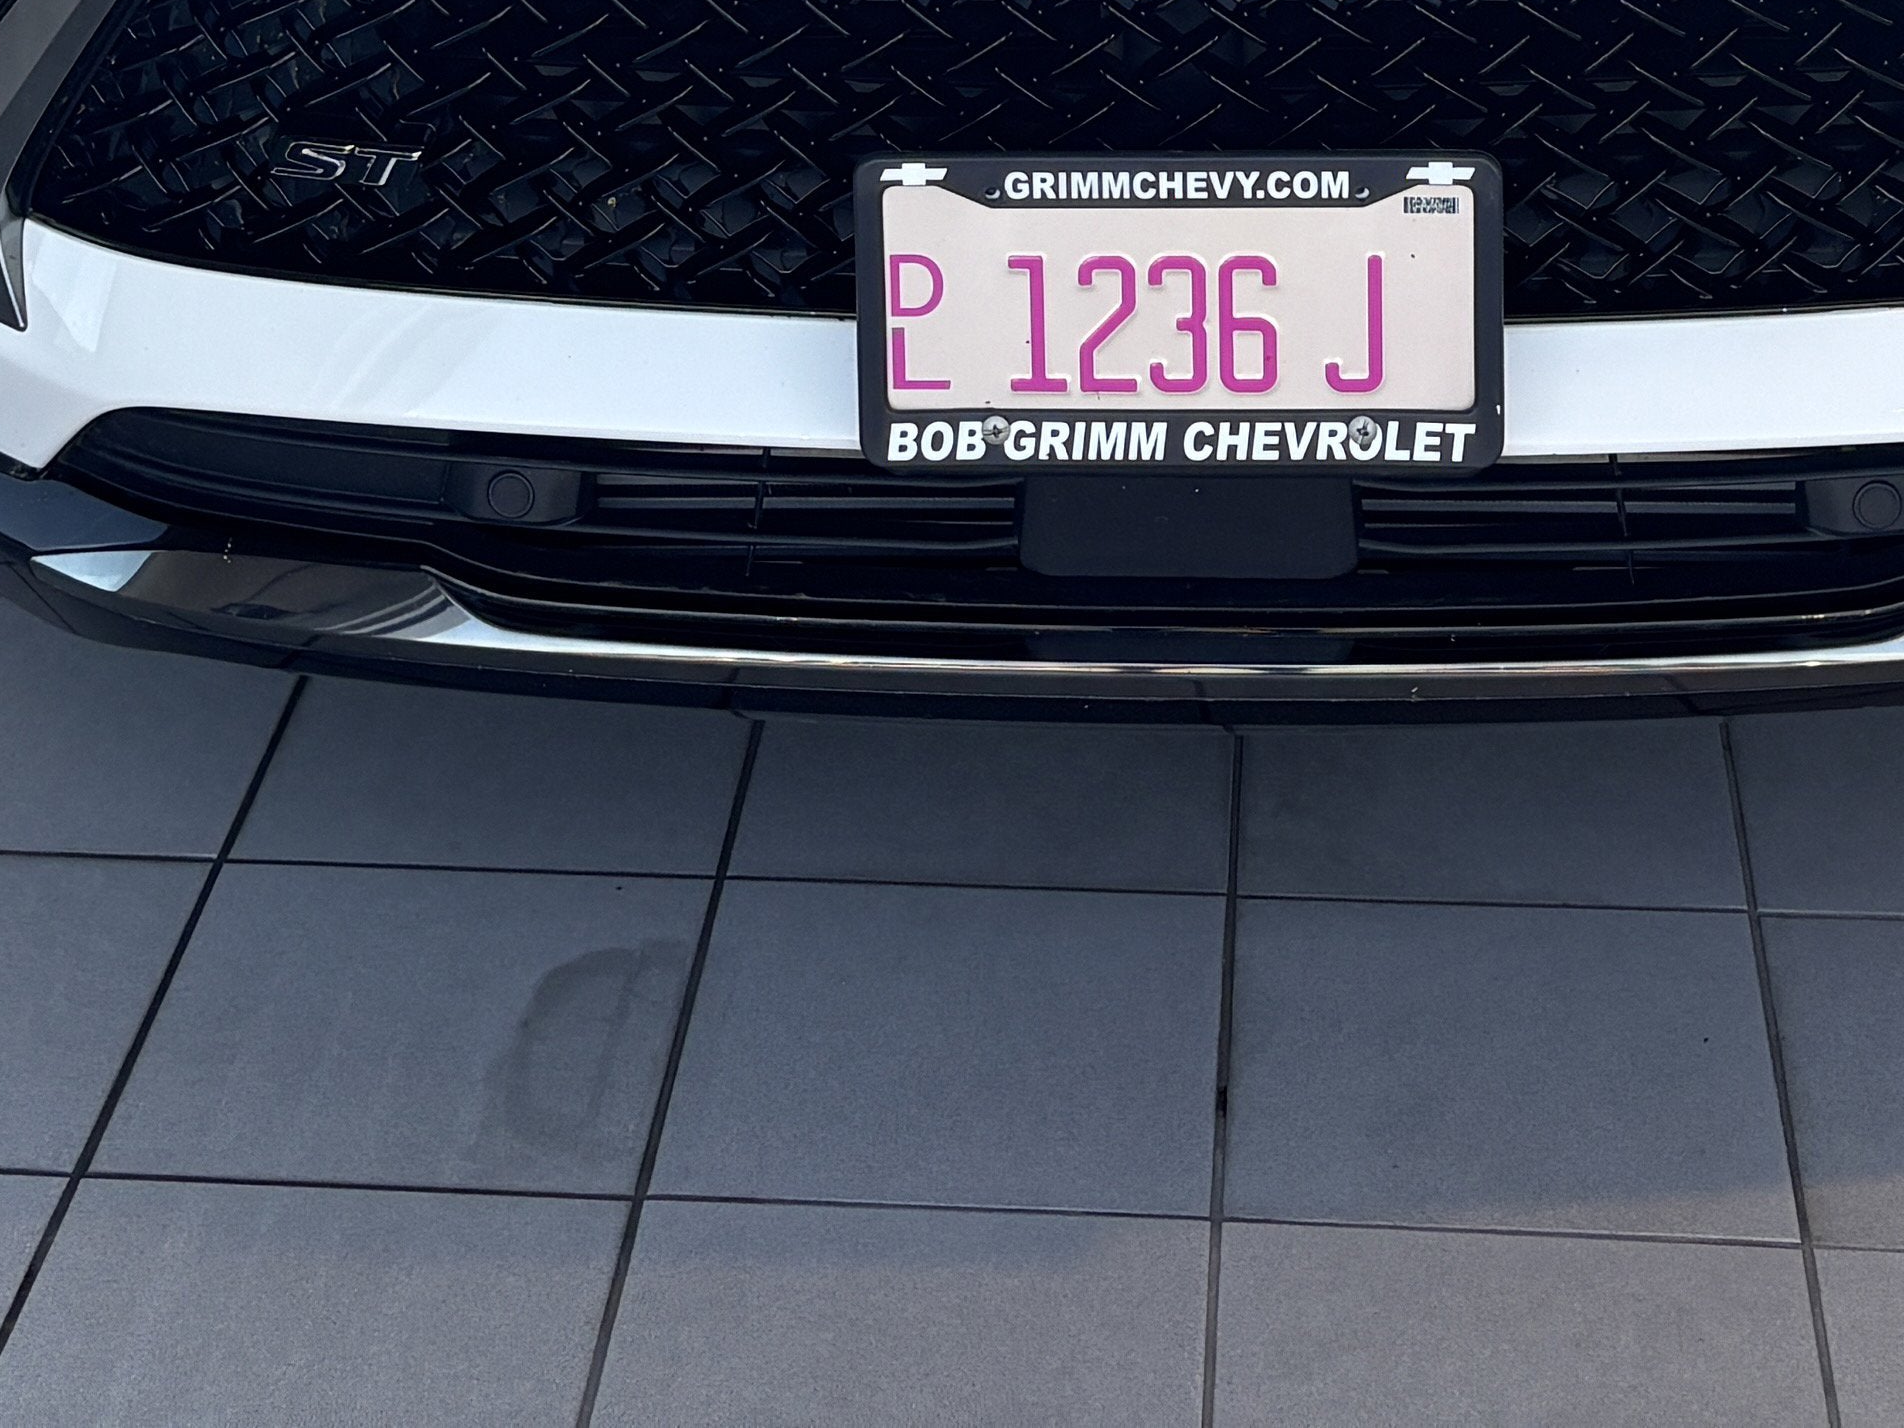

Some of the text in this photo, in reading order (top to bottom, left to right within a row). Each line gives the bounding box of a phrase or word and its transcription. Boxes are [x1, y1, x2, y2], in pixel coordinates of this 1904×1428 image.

[271, 141, 424, 186] ST
[1003, 170, 1351, 202] GRIMMCHEVY.COM
[1007, 254, 1279, 393] 1236
[1324, 254, 1385, 393] J
[887, 420, 1477, 463] BOB GRIMM CHEVROLET
